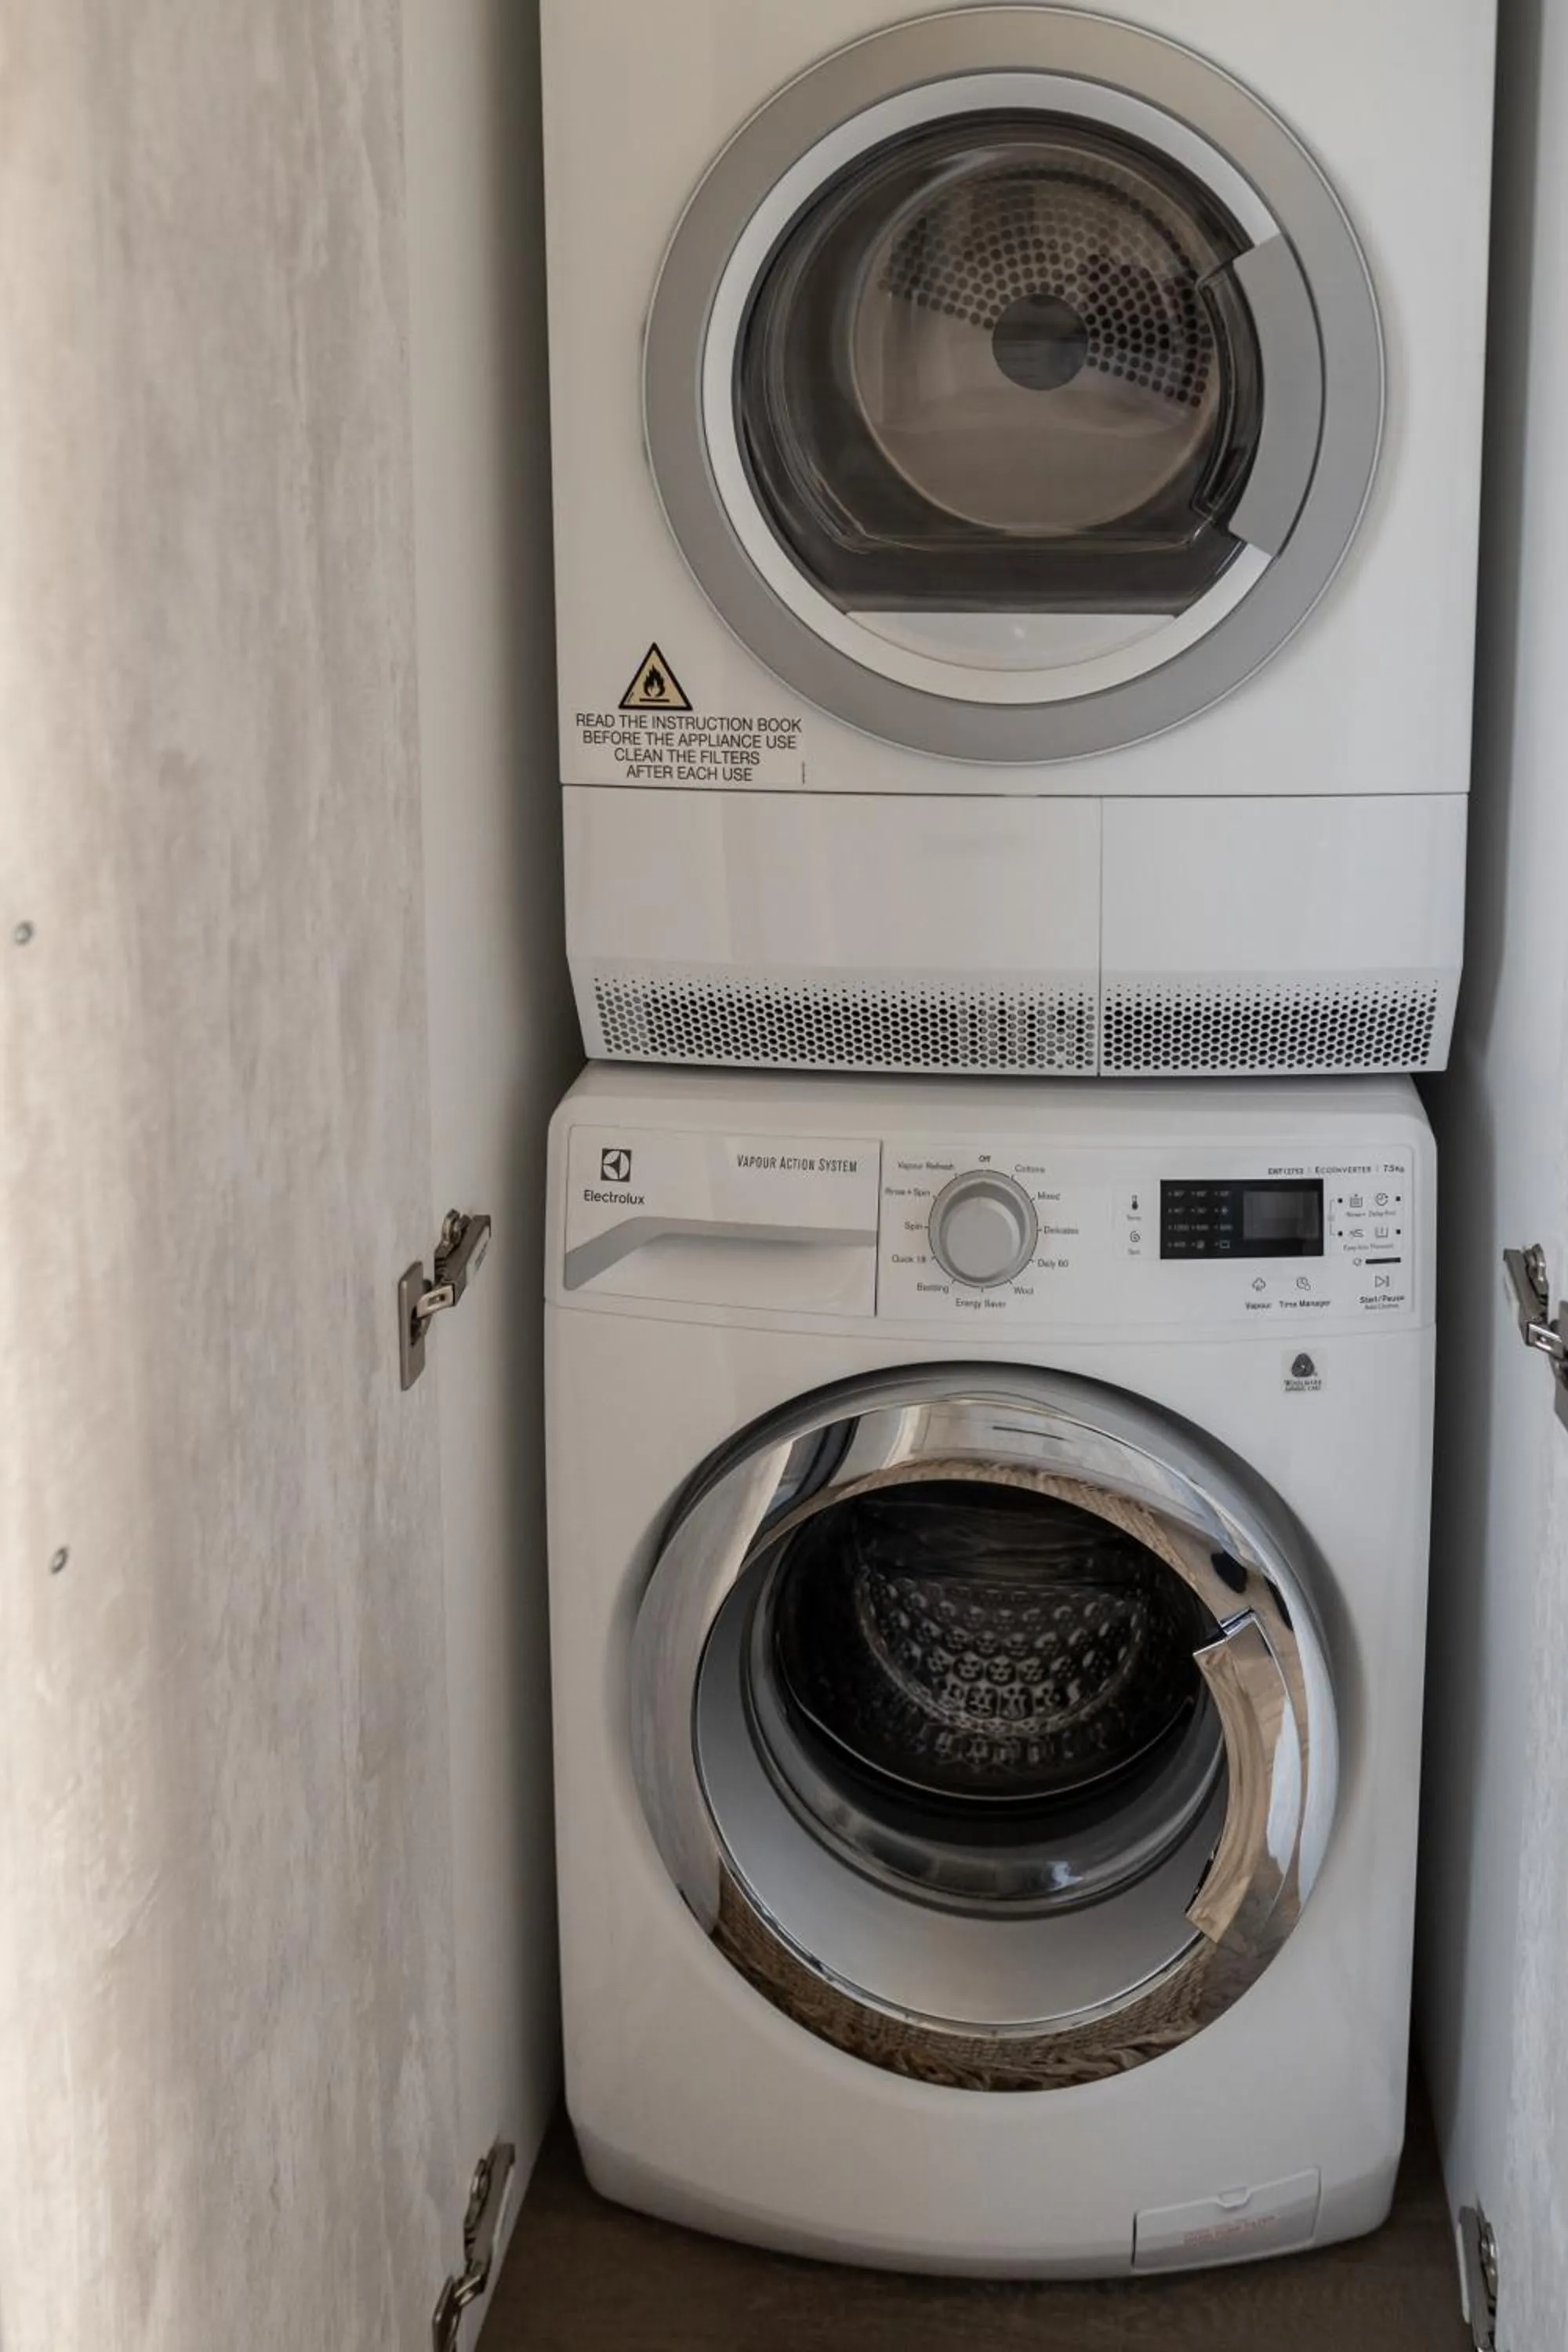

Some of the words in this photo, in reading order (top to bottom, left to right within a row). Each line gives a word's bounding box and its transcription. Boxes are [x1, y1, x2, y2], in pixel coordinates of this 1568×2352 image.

[575, 713, 615, 728] READ
[620, 714, 648, 729] THE
[652, 716, 753, 731] INSTRUCTION
[758, 718, 802, 732] BOOK
[583, 731, 641, 746] BEFORE
[645, 732, 673, 746] THE
[679, 733, 761, 749] APPLIANCE
[767, 735, 797, 750] USE
[615, 748, 663, 762] CLEAN
[667, 750, 695, 764] THE
[700, 750, 760, 765] FILTERS
[626, 765, 672, 779] AFTER
[677, 766, 717, 780] EACH
[723, 768, 753, 782] USE
[737, 1154, 776, 1170] VAPOUR
[780, 1156, 815, 1171] ACTION
[818, 1158, 857, 1173] SYSTEM
[583, 1189, 645, 1206] Electrolux
